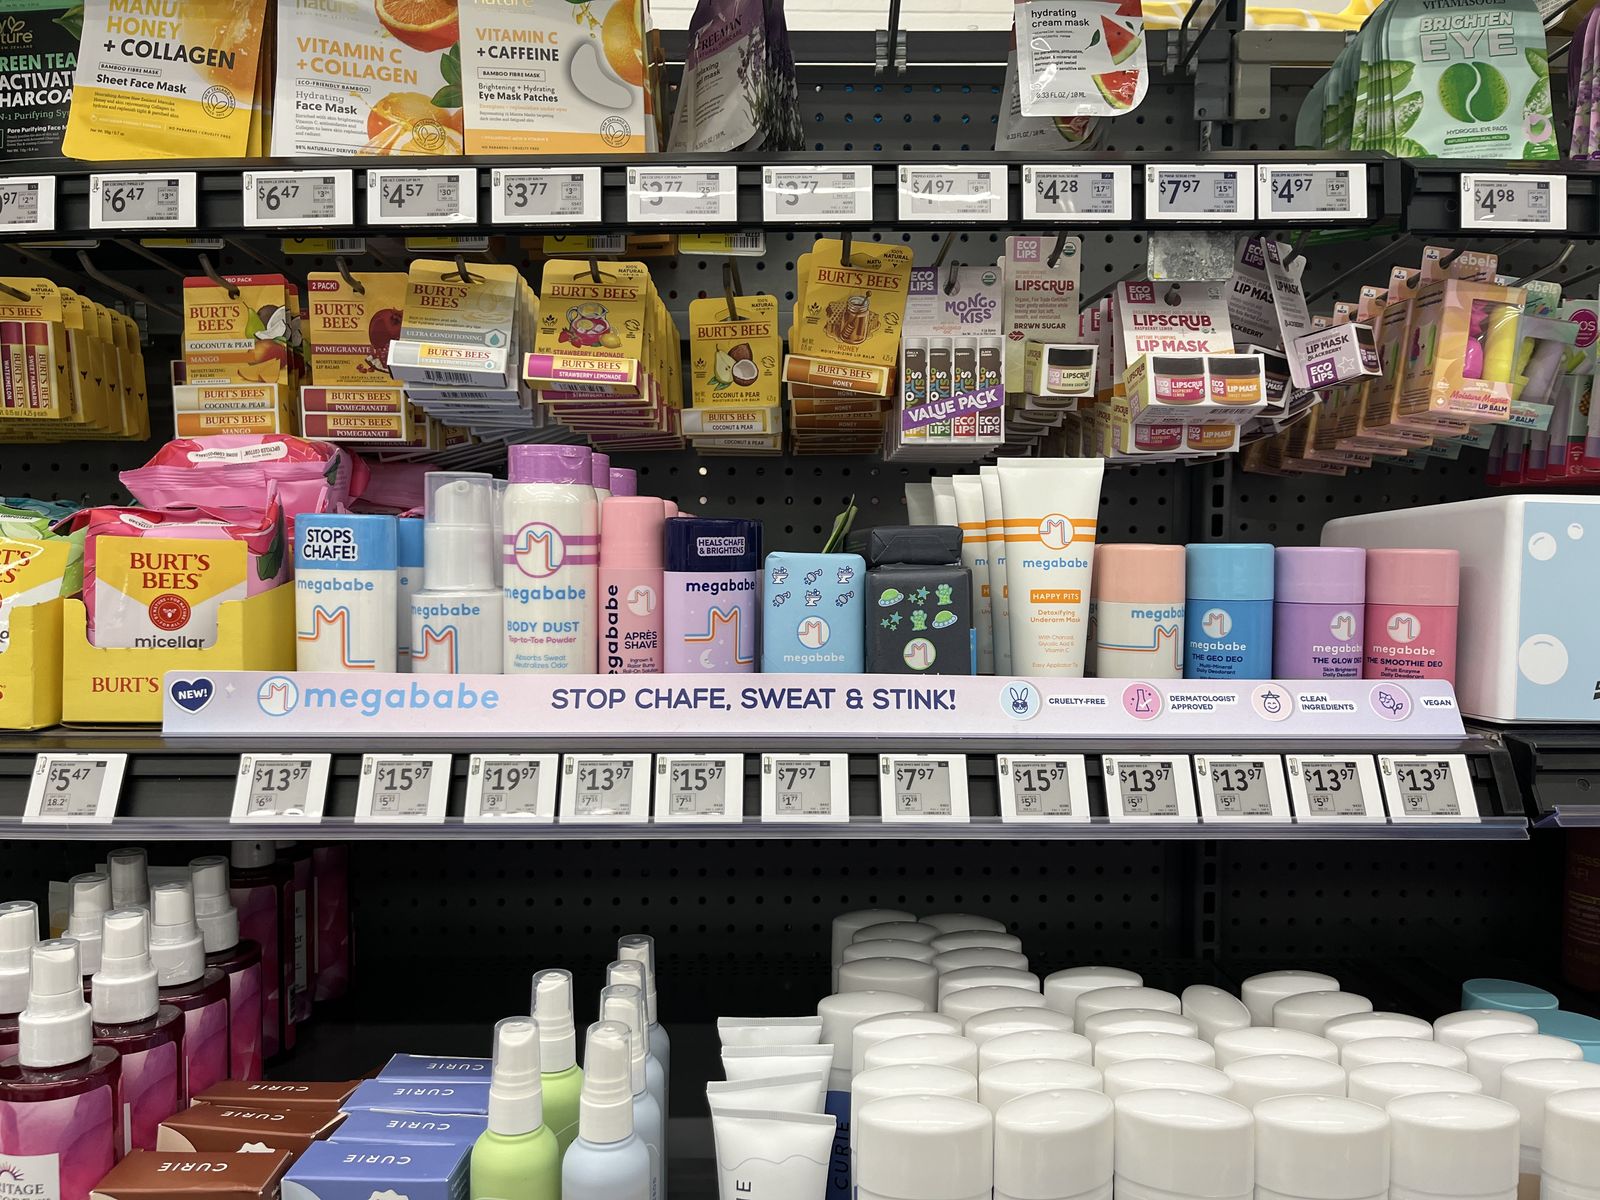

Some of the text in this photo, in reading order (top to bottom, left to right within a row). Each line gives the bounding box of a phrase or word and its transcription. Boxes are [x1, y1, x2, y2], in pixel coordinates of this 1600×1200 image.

[1031, 8, 1077, 18] hydrating
[107, 16, 181, 40] HONEY
[1031, 18, 1089, 28] cream mask
[1419, 11, 1513, 33] BRIGHTEN
[476, 28, 558, 45] VITAMIN C
[297, 37, 402, 64] VITAMIN C
[1420, 27, 1518, 63] EYE
[121, 38, 235, 70] COLLAGEN
[96, 74, 187, 94] Sheet Face Mask
[297, 81, 369, 93] ECO-FRIENDLY BAMBOO
[479, 83, 515, 93] Brightening
[523, 85, 556, 94] Hydrating
[296, 91, 344, 104] Hydrating
[479, 92, 558, 104] Eye Mask Patches
[296, 101, 358, 115] Face Mask
[1446, 127, 1479, 136] HYDROGEL
[1480, 126, 1491, 134] EYE
[1016, 241, 1038, 250] ECO
[883, 253, 909, 261] NATURAL
[1016, 250, 1038, 259] LIPS
[818, 269, 901, 289] BURT'S BEES
[414, 284, 470, 298] BURT'S
[1015, 280, 1075, 295] LIPSCRUB
[420, 295, 459, 308] BEES
[945, 293, 997, 317] MONGO
[190, 305, 240, 318] BURT'S
[960, 308, 993, 324] KISS
[198, 319, 234, 331] BEES
[323, 318, 361, 329] BEES
[1041, 322, 1066, 330] SUGAR
[1132, 314, 1212, 332] LIPSCRUB
[406, 330, 482, 342] ULTRA CONDITIONING
[190, 342, 226, 350] COCONUT
[837, 344, 860, 353] HONEY
[1136, 340, 1210, 353] LIP MASK
[1306, 342, 1320, 355] LIP
[1321, 334, 1349, 351] MASK
[191, 356, 219, 364] MANGO
[1310, 362, 1332, 374] ECO
[4, 360, 13, 400] WATERMELON
[558, 371, 593, 379] STRAWBERRY
[1312, 372, 1335, 384] LIPS
[832, 379, 853, 388] HONEY
[908, 388, 999, 423] VALUE PACK
[1488, 404, 1508, 412] BALM
[307, 529, 352, 544] STOPS
[698, 538, 744, 547] HEALS CHAFE
[303, 544, 356, 560] CHAFE!
[706, 546, 744, 555] BRIGHTENS
[130, 552, 211, 571] BURT'S
[1023, 557, 1089, 571] megababe
[142, 571, 200, 589] BEES
[297, 578, 374, 594] megababe
[686, 578, 756, 595] megababe
[504, 586, 586, 604] megababe
[1033, 592, 1080, 601] HAPPY PITS
[1037, 609, 1075, 618] Detoxifying
[1065, 616, 1081, 624] Mask
[507, 621, 580, 633] BODY DUST
[508, 635, 576, 645] Top-to-Toe Powder
[624, 629, 658, 640] APRÈS
[135, 634, 205, 649] micellar
[624, 640, 658, 650] SHAVE
[1190, 639, 1246, 652] megababe
[1372, 644, 1435, 656] megababe
[515, 654, 566, 662] Absorbs Sweat
[784, 652, 845, 665] megababe
[1192, 653, 1243, 663] THE GEO DEO
[1367, 656, 1443, 667] THE SMOOTHIE DEO
[513, 661, 568, 669] Neutralizes Odor
[91, 677, 159, 693] BURT'S
[178, 687, 208, 699] NEW!
[304, 681, 500, 717] megababe
[1169, 694, 1236, 702] DERMATOLOGIST
[551, 687, 956, 712] STOP CHAFE, SWEAT & STINK!
[1048, 697, 1106, 705] CRUELTY-FREE
[1171, 703, 1214, 711] APPROVED
[1302, 703, 1354, 711] INGREDIENTS
[393, 1086, 456, 1096] CURIE
[343, 1154, 412, 1165] CURIE
[834, 1121, 850, 1191] CURIE
[157, 1161, 229, 1173] CURIE
